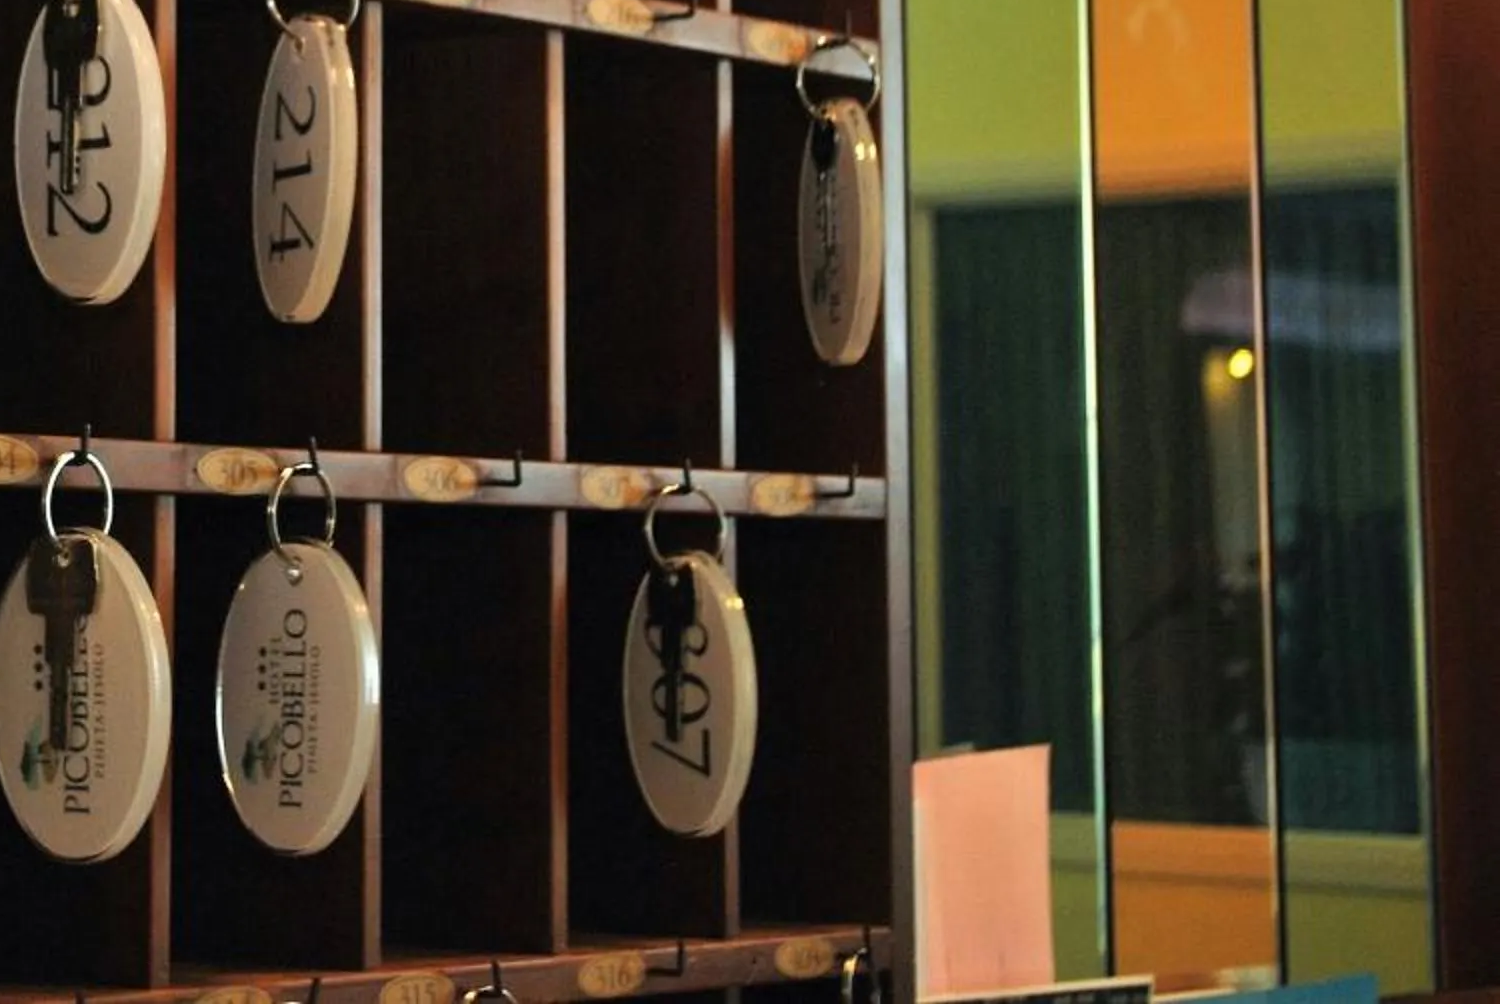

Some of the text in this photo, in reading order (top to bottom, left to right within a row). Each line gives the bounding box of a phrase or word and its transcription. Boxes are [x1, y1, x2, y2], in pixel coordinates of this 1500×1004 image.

[269, 85, 317, 263] 214
[218, 457, 259, 487] 305
[269, 635, 282, 705] HOTEL
[278, 608, 308, 809] PICOBELLO
[644, 619, 712, 779] 307
